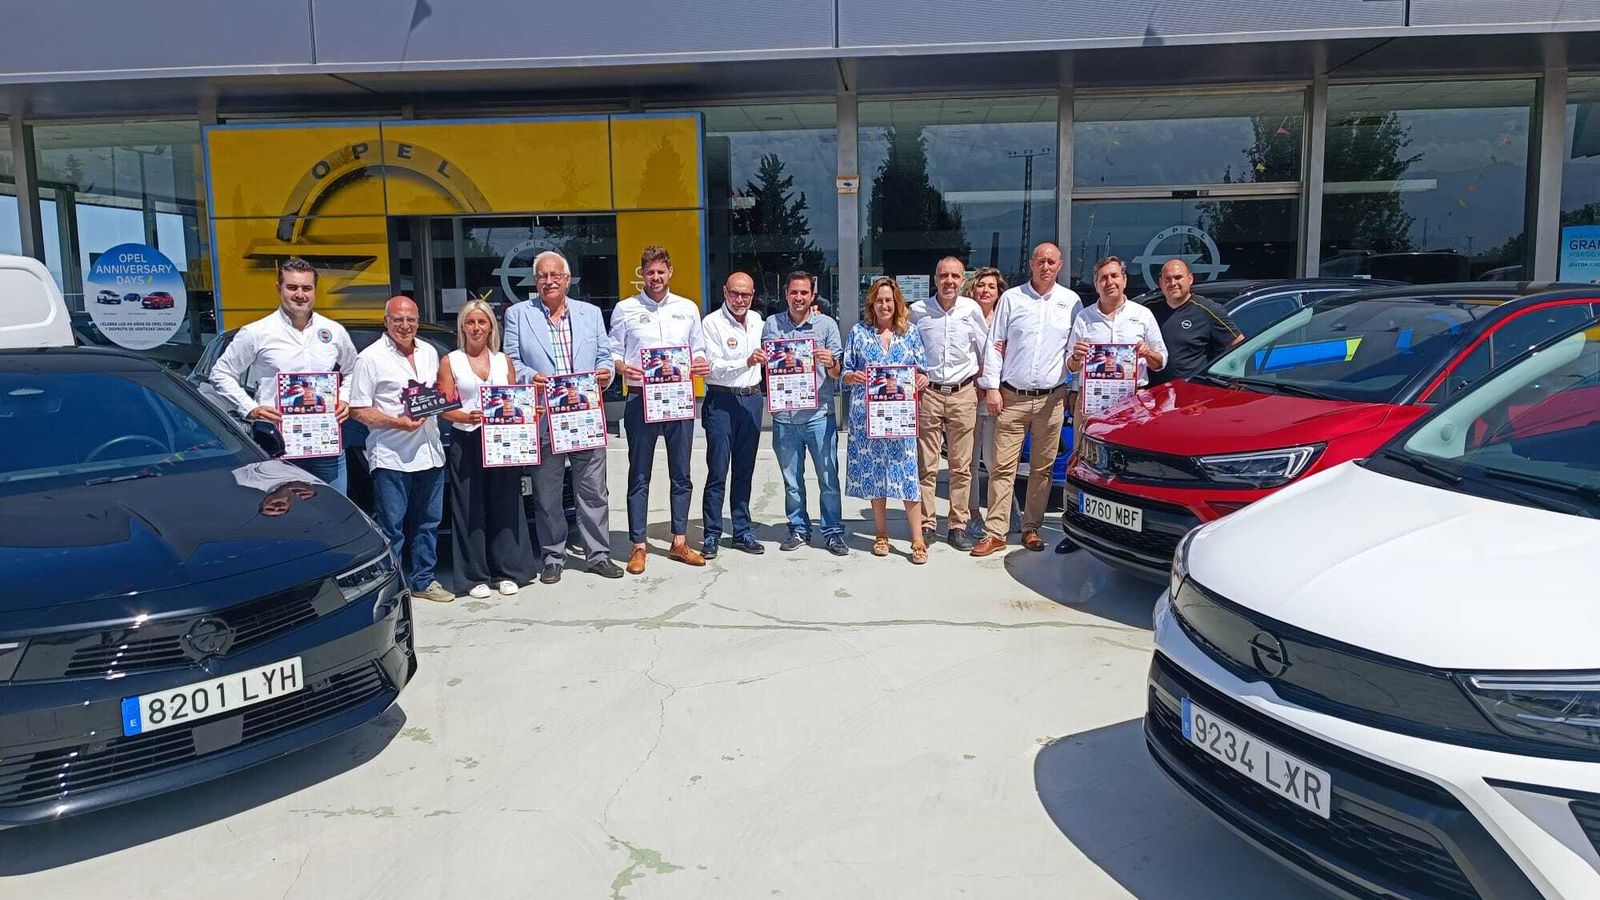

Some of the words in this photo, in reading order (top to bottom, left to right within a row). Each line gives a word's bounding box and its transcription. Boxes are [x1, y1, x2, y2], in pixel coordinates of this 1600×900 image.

[311, 143, 451, 179] OPEL
[1157, 227, 1206, 240] OPEL
[118, 253, 147, 263] OPEL
[95, 264, 172, 274] ANNIVERSARY
[116, 275, 145, 285] DAYS
[1085, 497, 1112, 520] 8760
[1115, 506, 1139, 527] MBF
[148, 683, 226, 724] 8201
[242, 664, 297, 702] LYH
[130, 719, 137, 727] E
[1195, 714, 1254, 773] 9234
[1265, 751, 1321, 811] LXR
